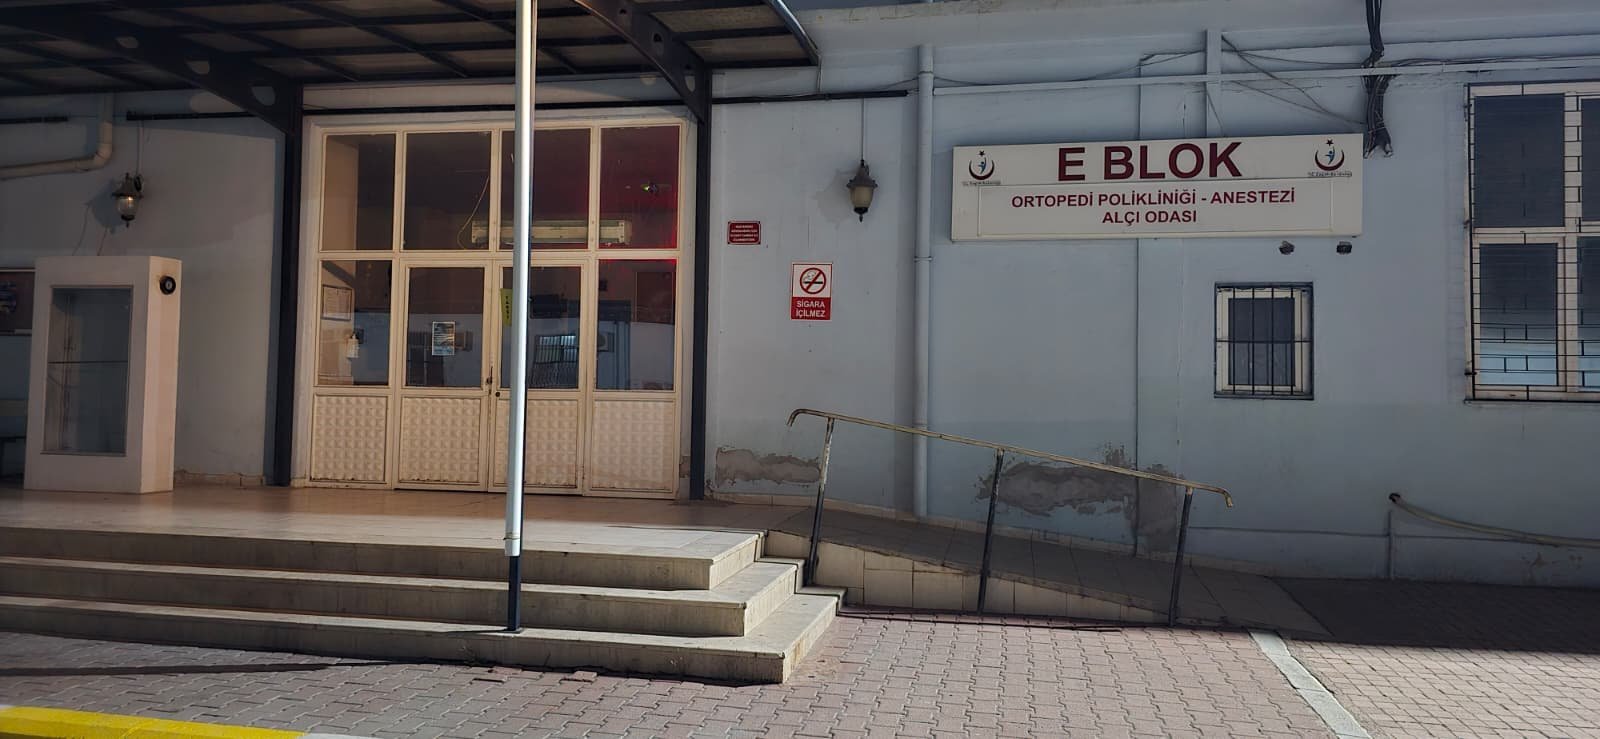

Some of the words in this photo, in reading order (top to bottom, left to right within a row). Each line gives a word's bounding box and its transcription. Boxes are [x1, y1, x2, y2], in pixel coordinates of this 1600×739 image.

[1058, 147, 1086, 182] E
[1103, 142, 1243, 180] BLOK
[1011, 191, 1093, 208] ORTOPEDİ
[1098, 188, 1197, 207] POLİKLİNİĞİ
[1210, 187, 1295, 205] ANESTEZİ
[1102, 212, 1140, 227] ALÇI
[1145, 210, 1197, 224] ODASI
[796, 299, 826, 309] SİGARA
[796, 308, 826, 318] İÇİLMEZ
